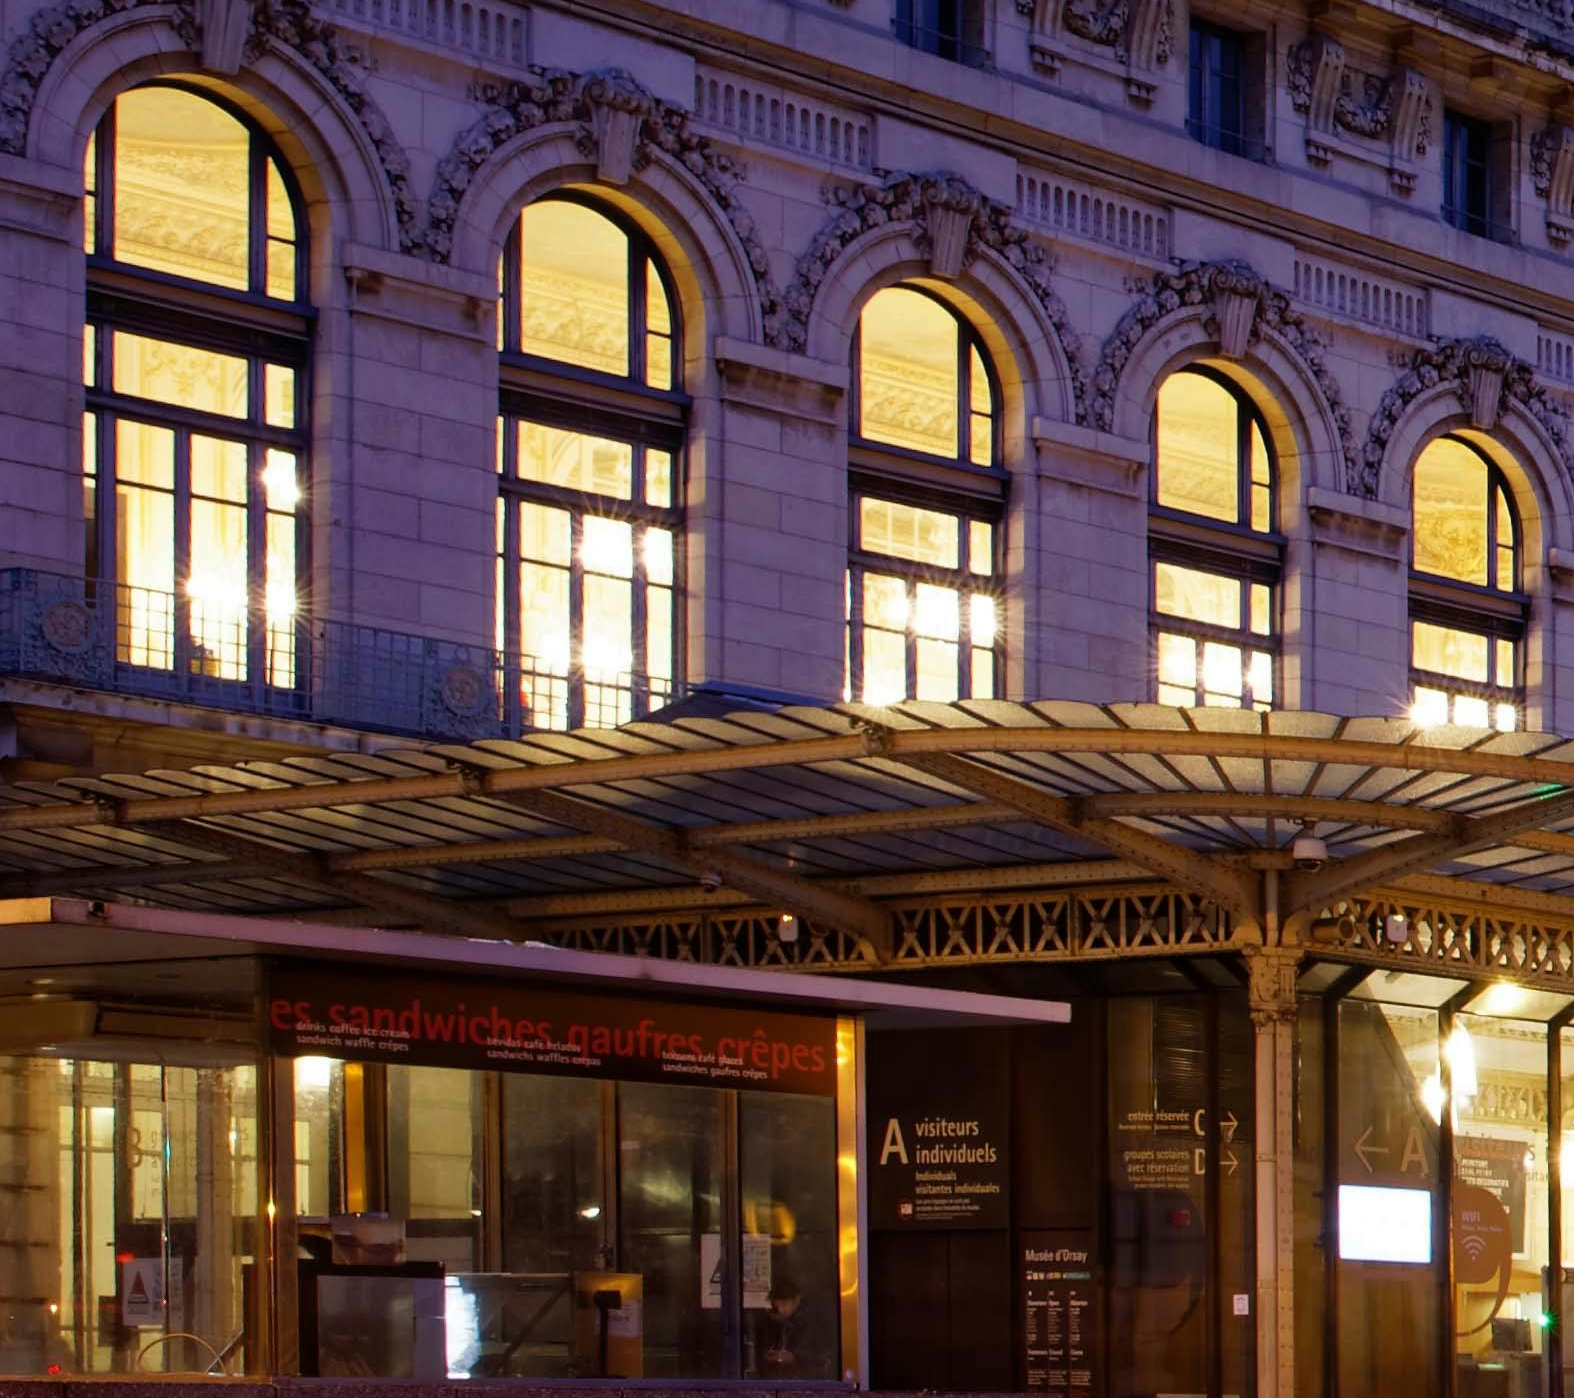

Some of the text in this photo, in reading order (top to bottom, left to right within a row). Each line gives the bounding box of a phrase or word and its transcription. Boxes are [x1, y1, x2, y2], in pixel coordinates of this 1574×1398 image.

[327, 1000, 553, 1048] sandwiches
[567, 1019, 703, 1060] gaufres
[716, 1026, 826, 1080] crêpes
[879, 1117, 910, 1166] A
[915, 1117, 980, 1138] visiteurs
[916, 1142, 998, 1165] individuels
[1400, 1126, 1430, 1174] A
[1025, 1249, 1088, 1264] Musée d'Orsay
